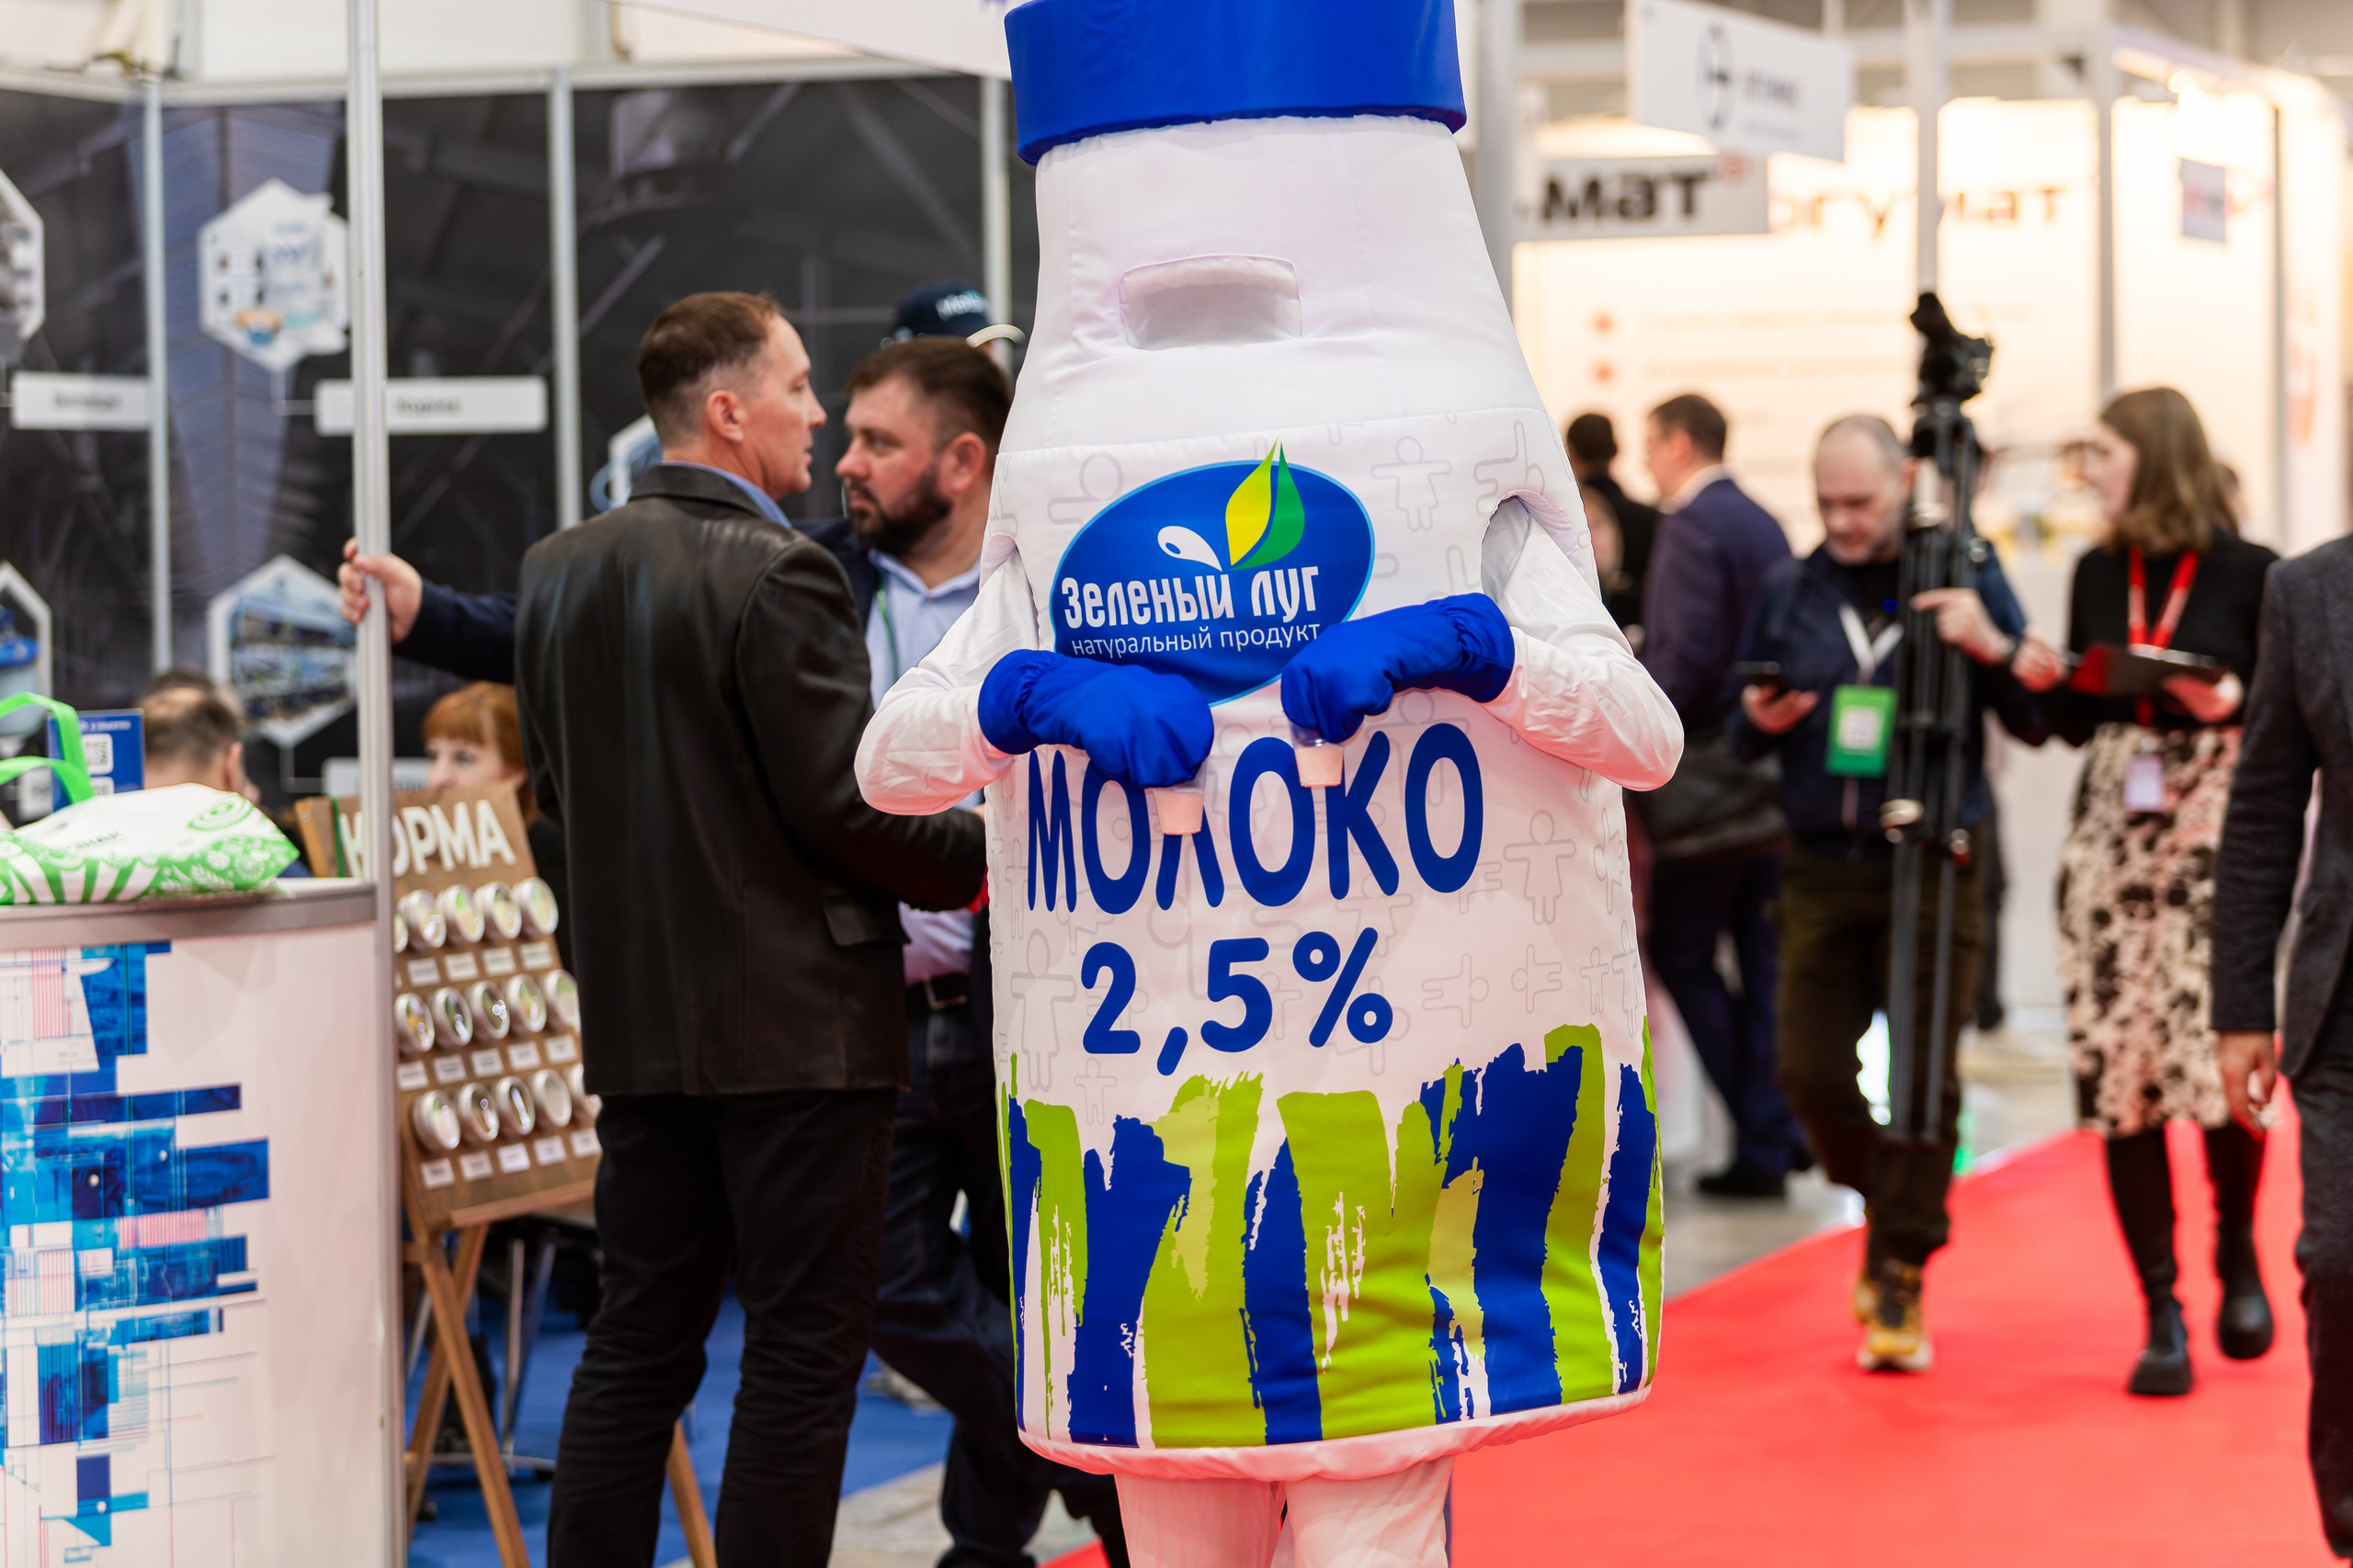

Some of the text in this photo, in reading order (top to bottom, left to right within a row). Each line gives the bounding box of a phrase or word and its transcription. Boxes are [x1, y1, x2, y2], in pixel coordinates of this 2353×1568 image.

[1072, 624, 1321, 659] натуральный продукт
[1251, 566, 1319, 623] луг
[1028, 722, 1483, 915] МОЛОКО
[1081, 927, 1393, 1075] 2,5%
